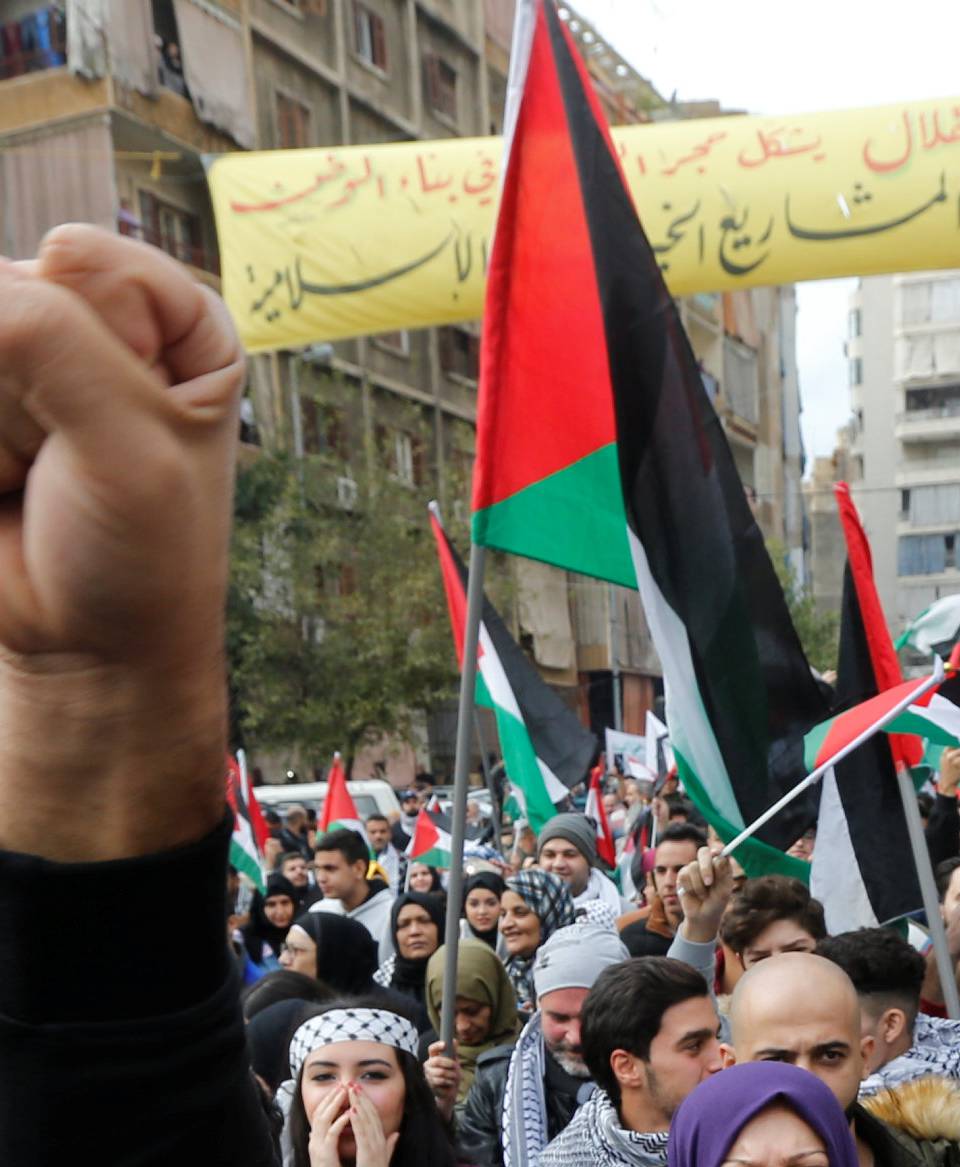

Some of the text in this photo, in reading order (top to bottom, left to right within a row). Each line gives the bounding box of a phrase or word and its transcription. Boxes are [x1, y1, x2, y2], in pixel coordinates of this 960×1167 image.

[229, 153, 386, 215] الوطن
[400, 152, 459, 204] بناء
[462, 150, 498, 207] في
